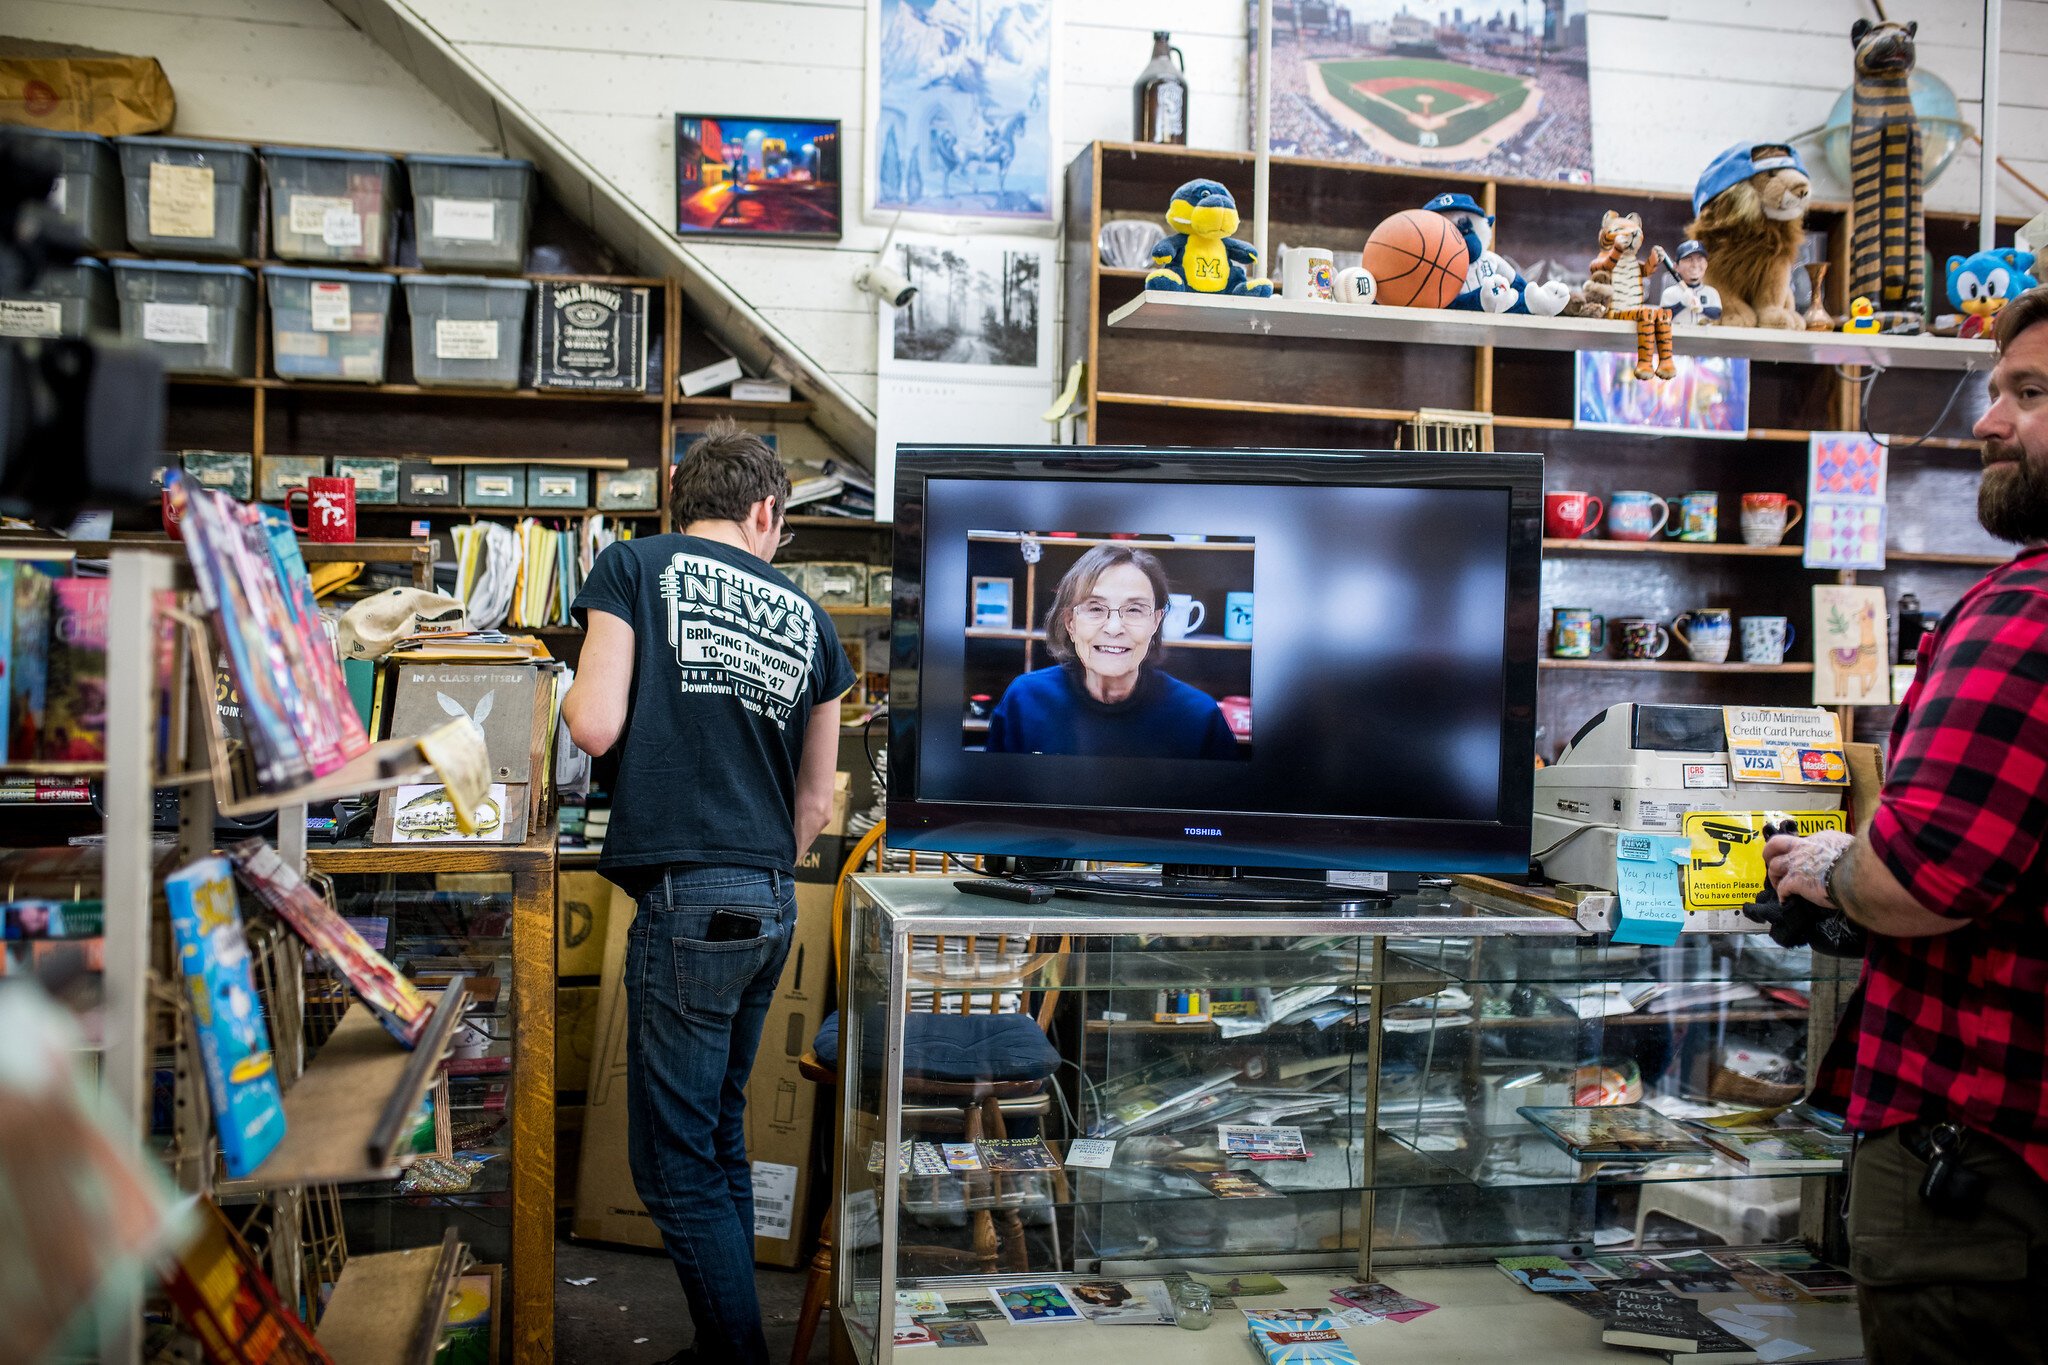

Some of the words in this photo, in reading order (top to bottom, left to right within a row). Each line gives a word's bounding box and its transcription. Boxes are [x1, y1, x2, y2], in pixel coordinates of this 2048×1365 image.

[1195, 257, 1221, 279] M
[1356, 276, 1371, 297] D
[313, 491, 346, 501] Michigan
[684, 574, 806, 642] NEWS
[701, 645, 718, 658] TO
[718, 652, 741, 669] OU
[761, 652, 800, 678] WORLD
[412, 673, 424, 683] IN
[427, 674, 436, 683] A
[439, 674, 470, 683] CLASS
[473, 674, 487, 683] BY
[490, 673, 523, 683] ITSELF
[681, 682, 732, 695] Downtown
[1741, 711, 1771, 723] $10.00
[1774, 712, 1820, 723] Minimum
[1732, 725, 1761, 736] Credit
[1763, 726, 1787, 737] Card
[1789, 728, 1833, 738] Purchase
[1689, 766, 1705, 774] CRS
[1743, 756, 1774, 770] VISA
[1803, 761, 1843, 771] MasterCard
[40, 790, 55, 799] LIFE
[56, 790, 86, 800] SAVERS
[1184, 827, 1223, 836] TOSHIBA
[1624, 840, 1648, 848] NEWS
[1622, 867, 1638, 878] You
[1645, 869, 1675, 880] must
[1638, 880, 1655, 896] 21
[1694, 882, 1731, 890] Attention
[1733, 881, 1762, 889] Please.
[1694, 892, 1710, 900] You
[1711, 891, 1730, 899] have
[1731, 891, 1758, 899] entere
[1636, 898, 1676, 911] purchase
[1638, 909, 1677, 919] tobacco
[1011, 1136, 1039, 1144] GUIDE
[1616, 1299, 1664, 1312] Proud
[1615, 1309, 1684, 1322] Fathers
